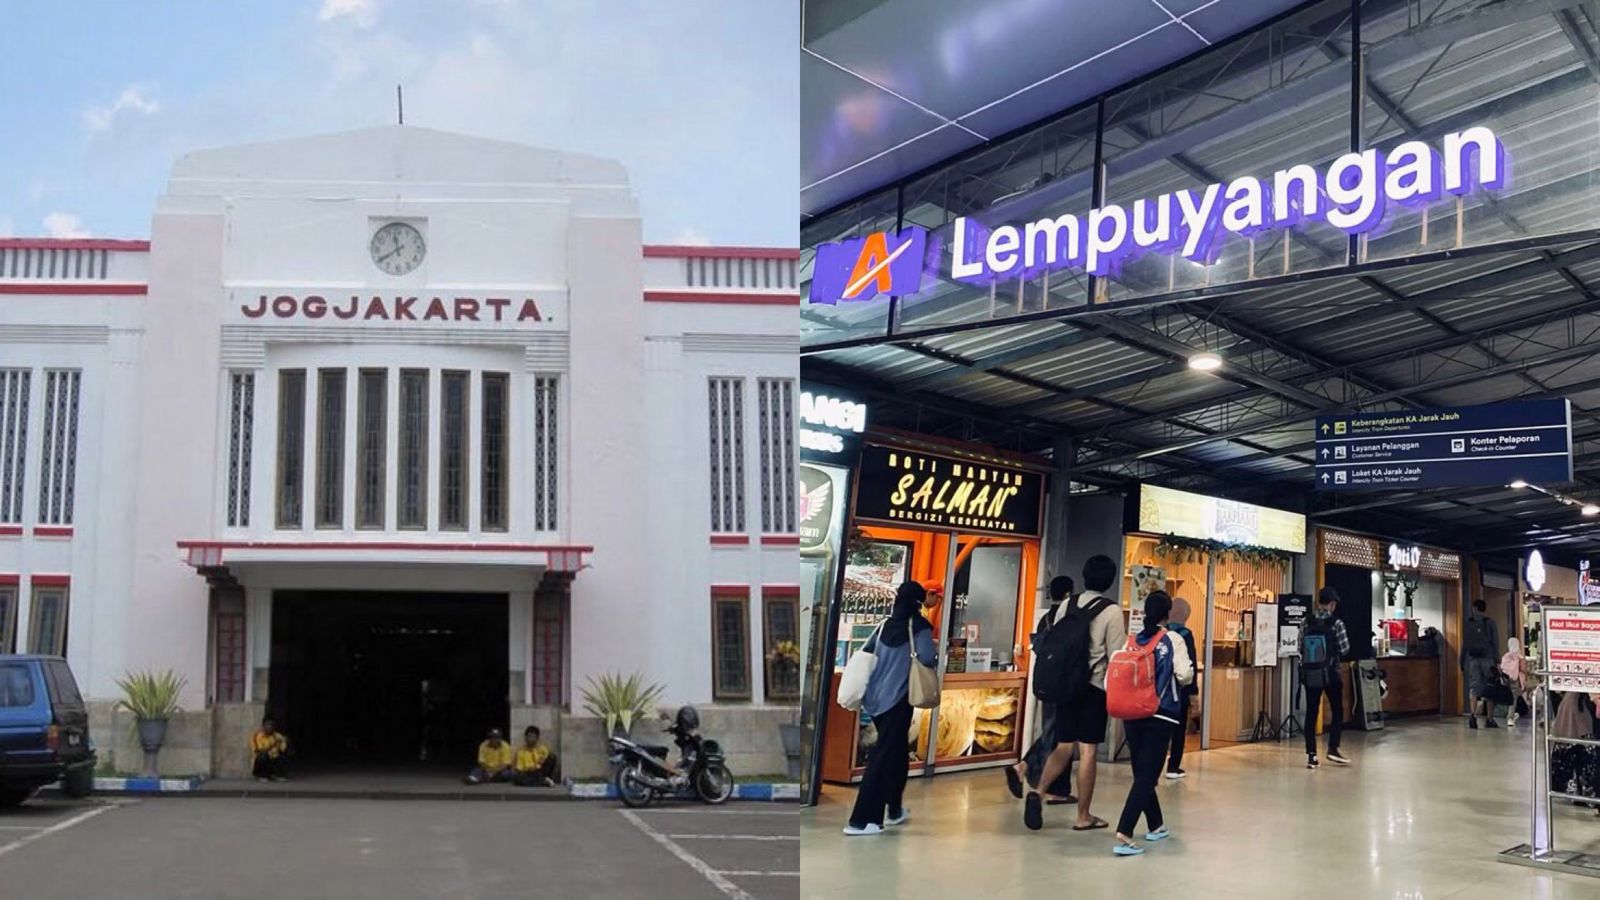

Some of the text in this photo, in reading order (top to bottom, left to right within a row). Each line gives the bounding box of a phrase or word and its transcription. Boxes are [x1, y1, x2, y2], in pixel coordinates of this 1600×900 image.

[952, 125, 1498, 282] Lempuyangan
[1352, 412, 1460, 427] Keberangkatan KA Jarak Jauh
[1352, 442, 1420, 453] Layanan Pelanggan
[1471, 435, 1540, 446] Konter Pelaporan
[889, 453, 1022, 486] ROTI MARYAM
[1383, 468, 1403, 476] Jarak
[1404, 467, 1422, 475] Jauh
[890, 474, 1011, 518] SALMAN
[889, 509, 1015, 530] BERGIZI KESEHATAN
